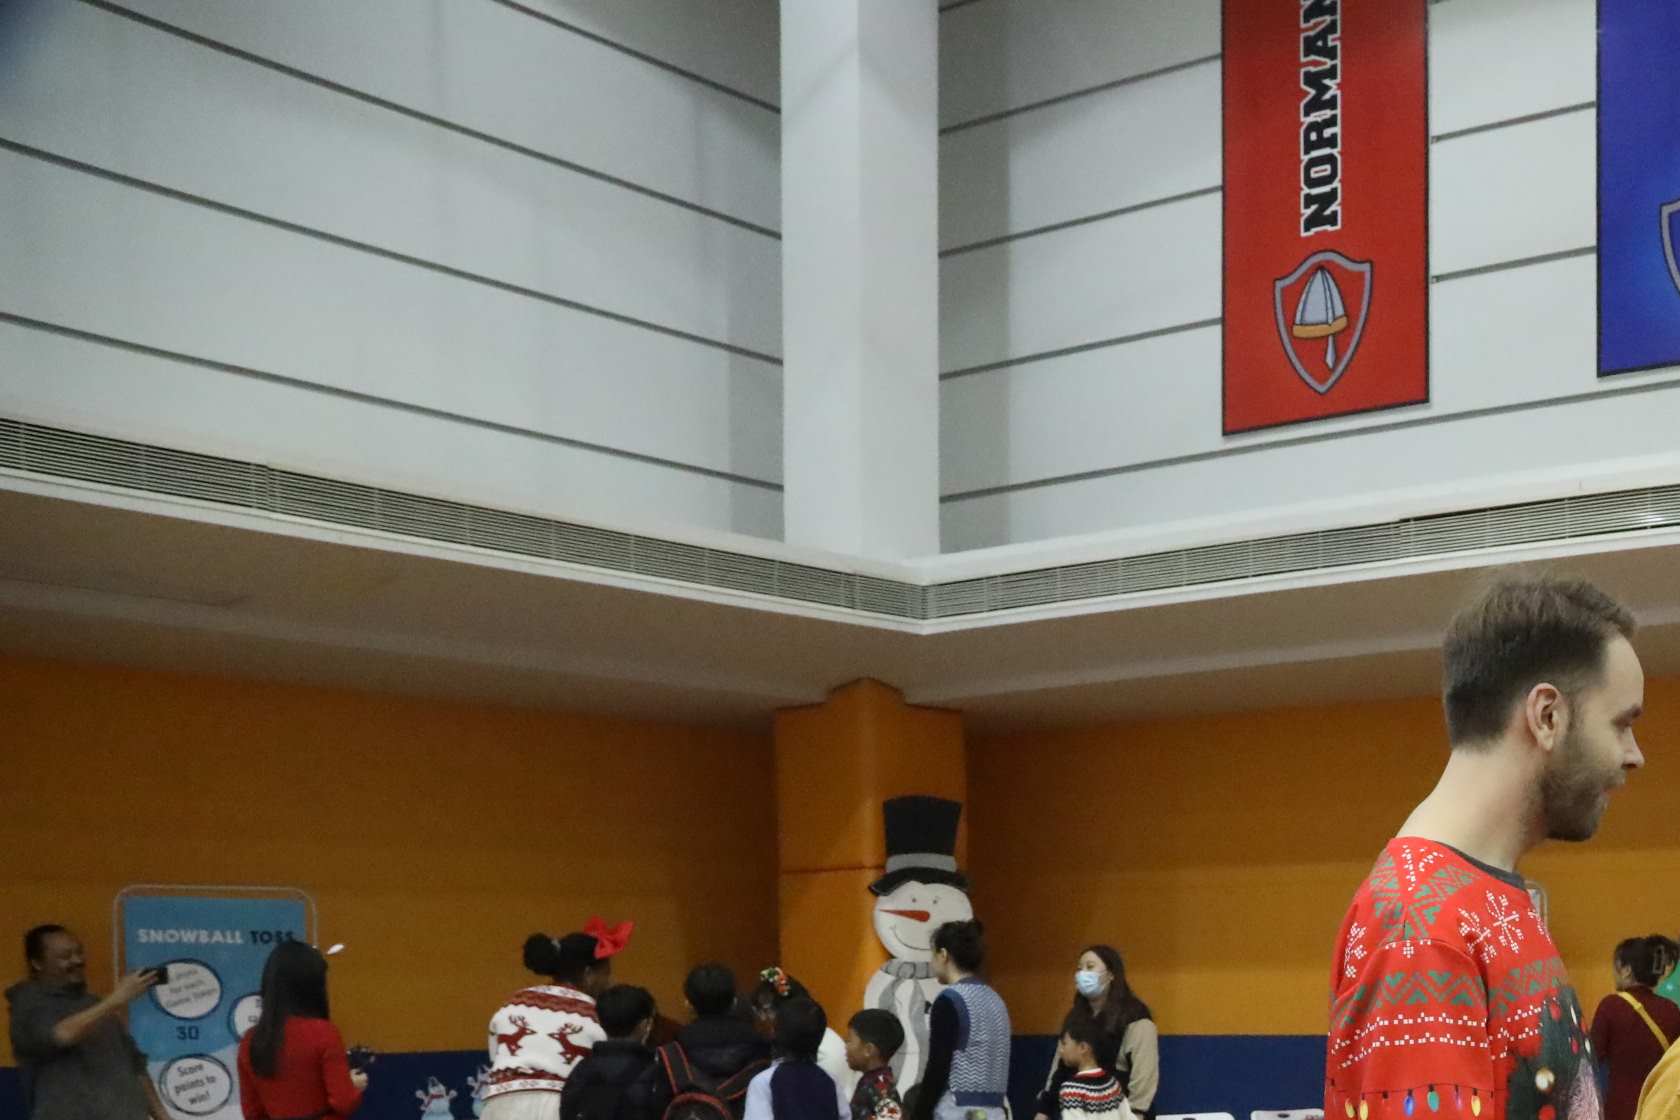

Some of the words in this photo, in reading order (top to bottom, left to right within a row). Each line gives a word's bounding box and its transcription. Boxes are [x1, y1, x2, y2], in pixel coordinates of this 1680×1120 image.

[138, 929, 243, 944] SNOWBALL
[176, 1025, 199, 1040] 30
[177, 1064, 204, 1076] Score
[175, 1079, 205, 1096] points
